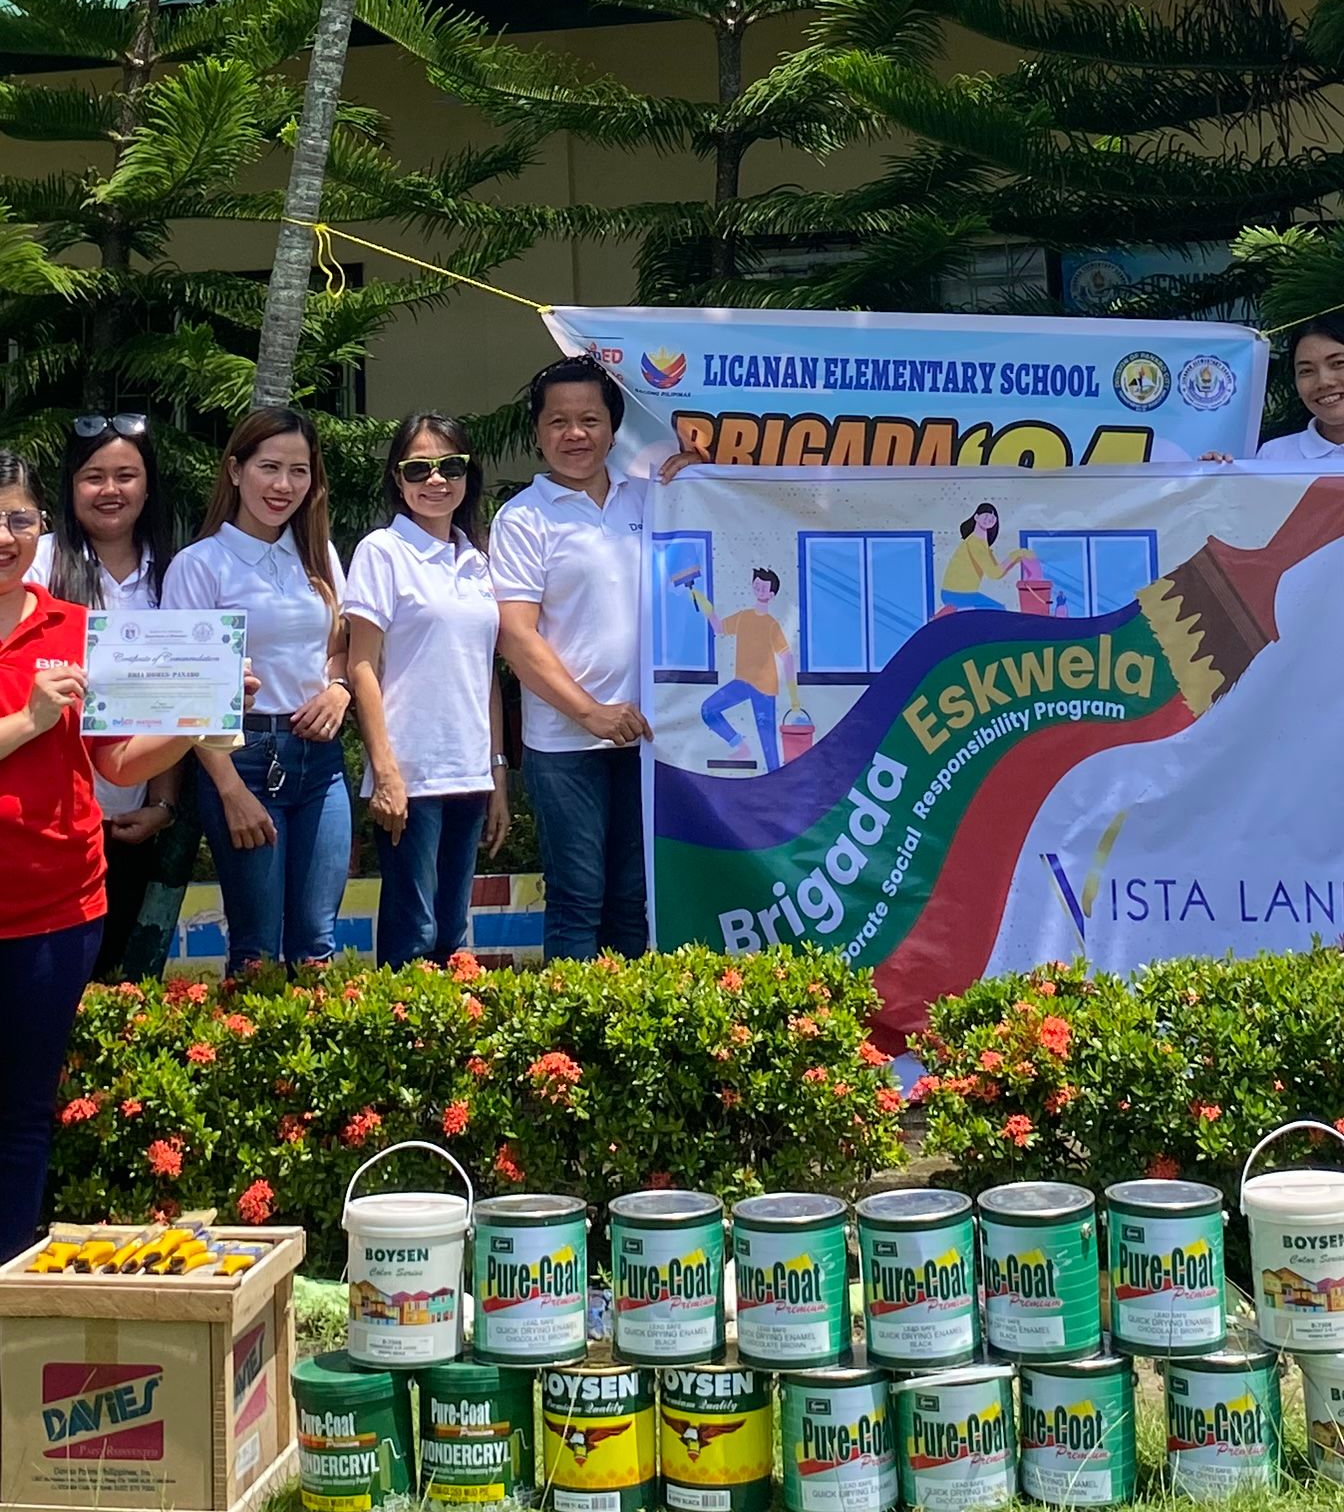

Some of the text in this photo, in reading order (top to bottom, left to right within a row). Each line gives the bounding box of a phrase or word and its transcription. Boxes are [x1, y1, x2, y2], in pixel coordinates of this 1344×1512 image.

[703, 353, 1099, 398] LICANAN ELEMENTARY SCHOOL
[674, 411, 956, 466] BRIGADA
[718, 633, 1155, 956] Brigada Eskwela
[881, 826, 923, 898] Social
[912, 708, 1033, 820] Responsibility
[1033, 699, 1126, 722] Program
[365, 1247, 430, 1262] BOYSEN
[1119, 1242, 1214, 1290] Pure-Coat
[1289, 1254, 1315, 1265] Color
[487, 1254, 579, 1300] Pure-Coat
[619, 1254, 712, 1301] Pure-Coat
[871, 1256, 968, 1304] Pure-Coat
[669, 1295, 717, 1312] Premium
[775, 1300, 828, 1316] Premium
[1008, 1292, 1064, 1308] Premium
[663, 1368, 754, 1397] OYSEN
[42, 1375, 163, 1442] DAVIES
[431, 1397, 491, 1425] Pure-Coat
[585, 1401, 625, 1415] Quality
[698, 1399, 738, 1413] Quality
[300, 1408, 357, 1437] Pure-Coat
[1055, 1443, 1110, 1460] Premium
[812, 1489, 837, 1498] QUICK
[846, 1497, 869, 1505] BLACK
